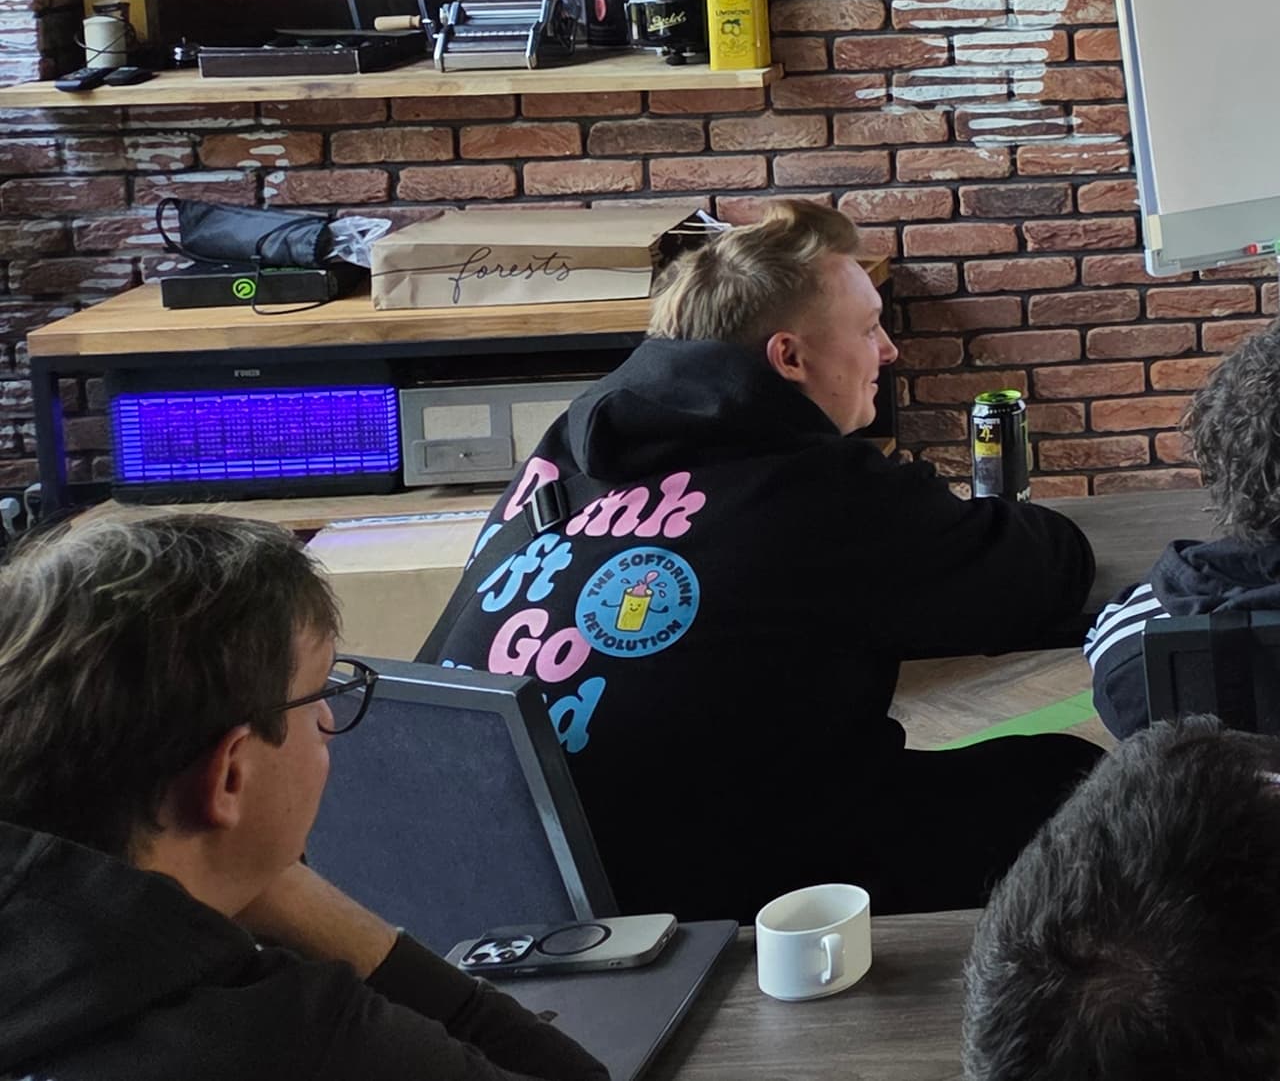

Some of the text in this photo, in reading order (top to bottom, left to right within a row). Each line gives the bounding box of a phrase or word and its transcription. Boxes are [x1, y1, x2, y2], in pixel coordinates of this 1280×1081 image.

[448, 246, 574, 304] forests
[503, 457, 706, 538] Dink
[586, 553, 693, 608] THE SOFTDRINK
[488, 608, 592, 683] Go
[583, 611, 683, 651] REVOLUTION
